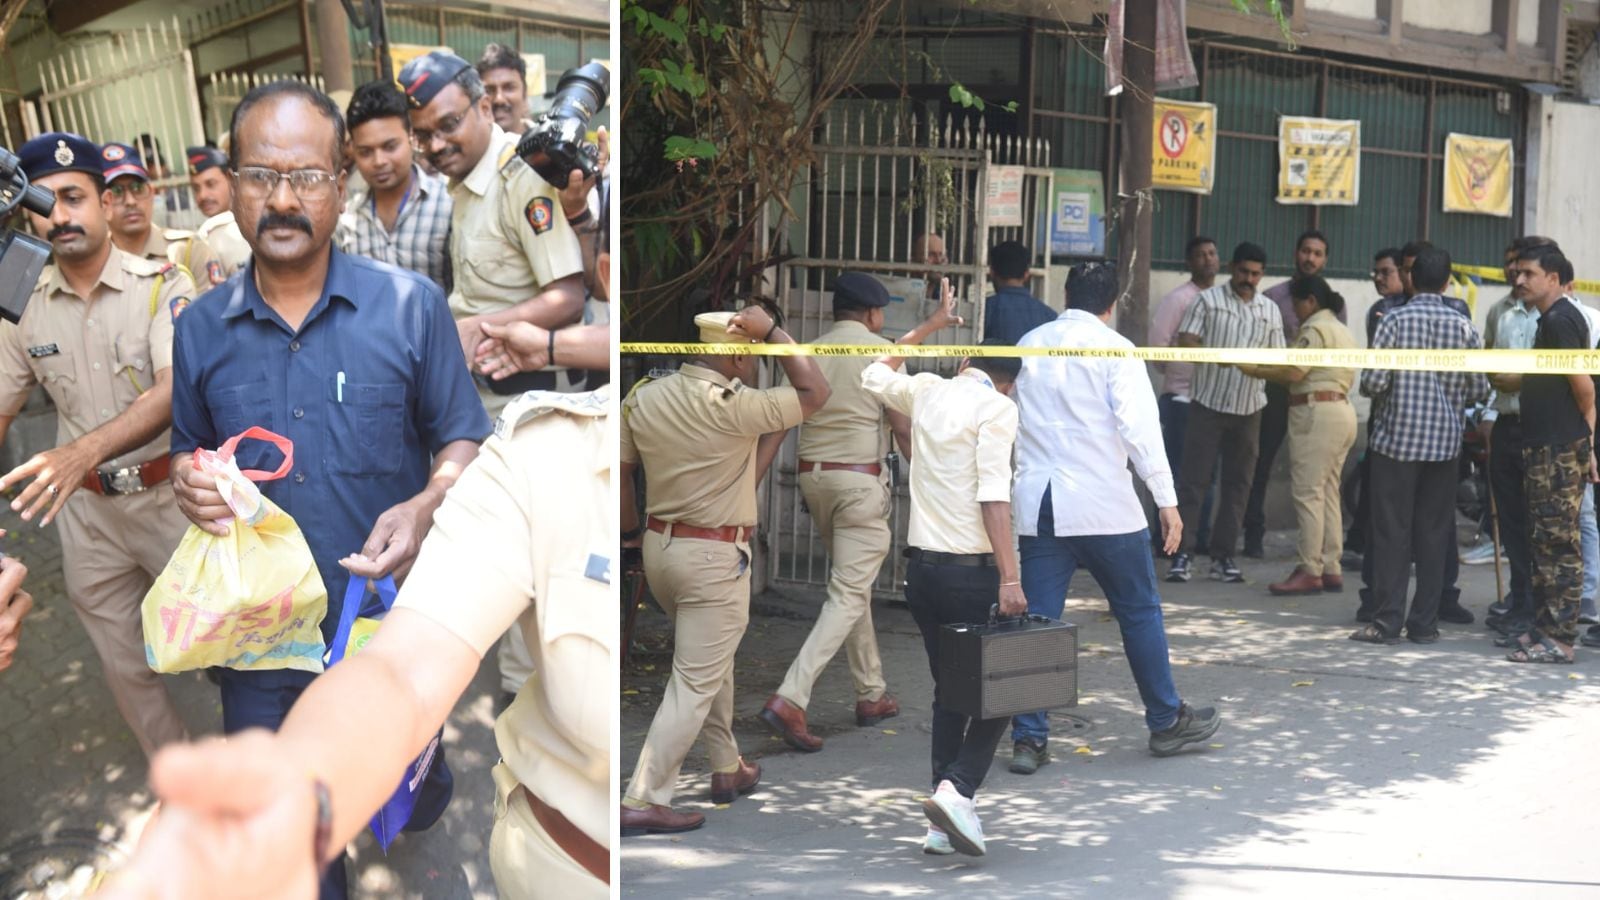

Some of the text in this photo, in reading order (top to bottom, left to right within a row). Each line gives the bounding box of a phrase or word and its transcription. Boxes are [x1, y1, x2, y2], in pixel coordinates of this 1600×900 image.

[1159, 158, 1198, 170] PARKING
[622, 345, 751, 355] SCENE DO NOT CROSS
[814, 347, 985, 357] CRIME SCENE DO NOT CROSS
[1048, 349, 1086, 357] CRIME
[1090, 350, 1127, 358] SCENE
[1133, 351, 1149, 359] DO
[1153, 351, 1176, 359] NOT
[1286, 354, 1467, 367] CRIME SCENE DO NOT CROSS
[1535, 354, 1579, 369] CRIME
